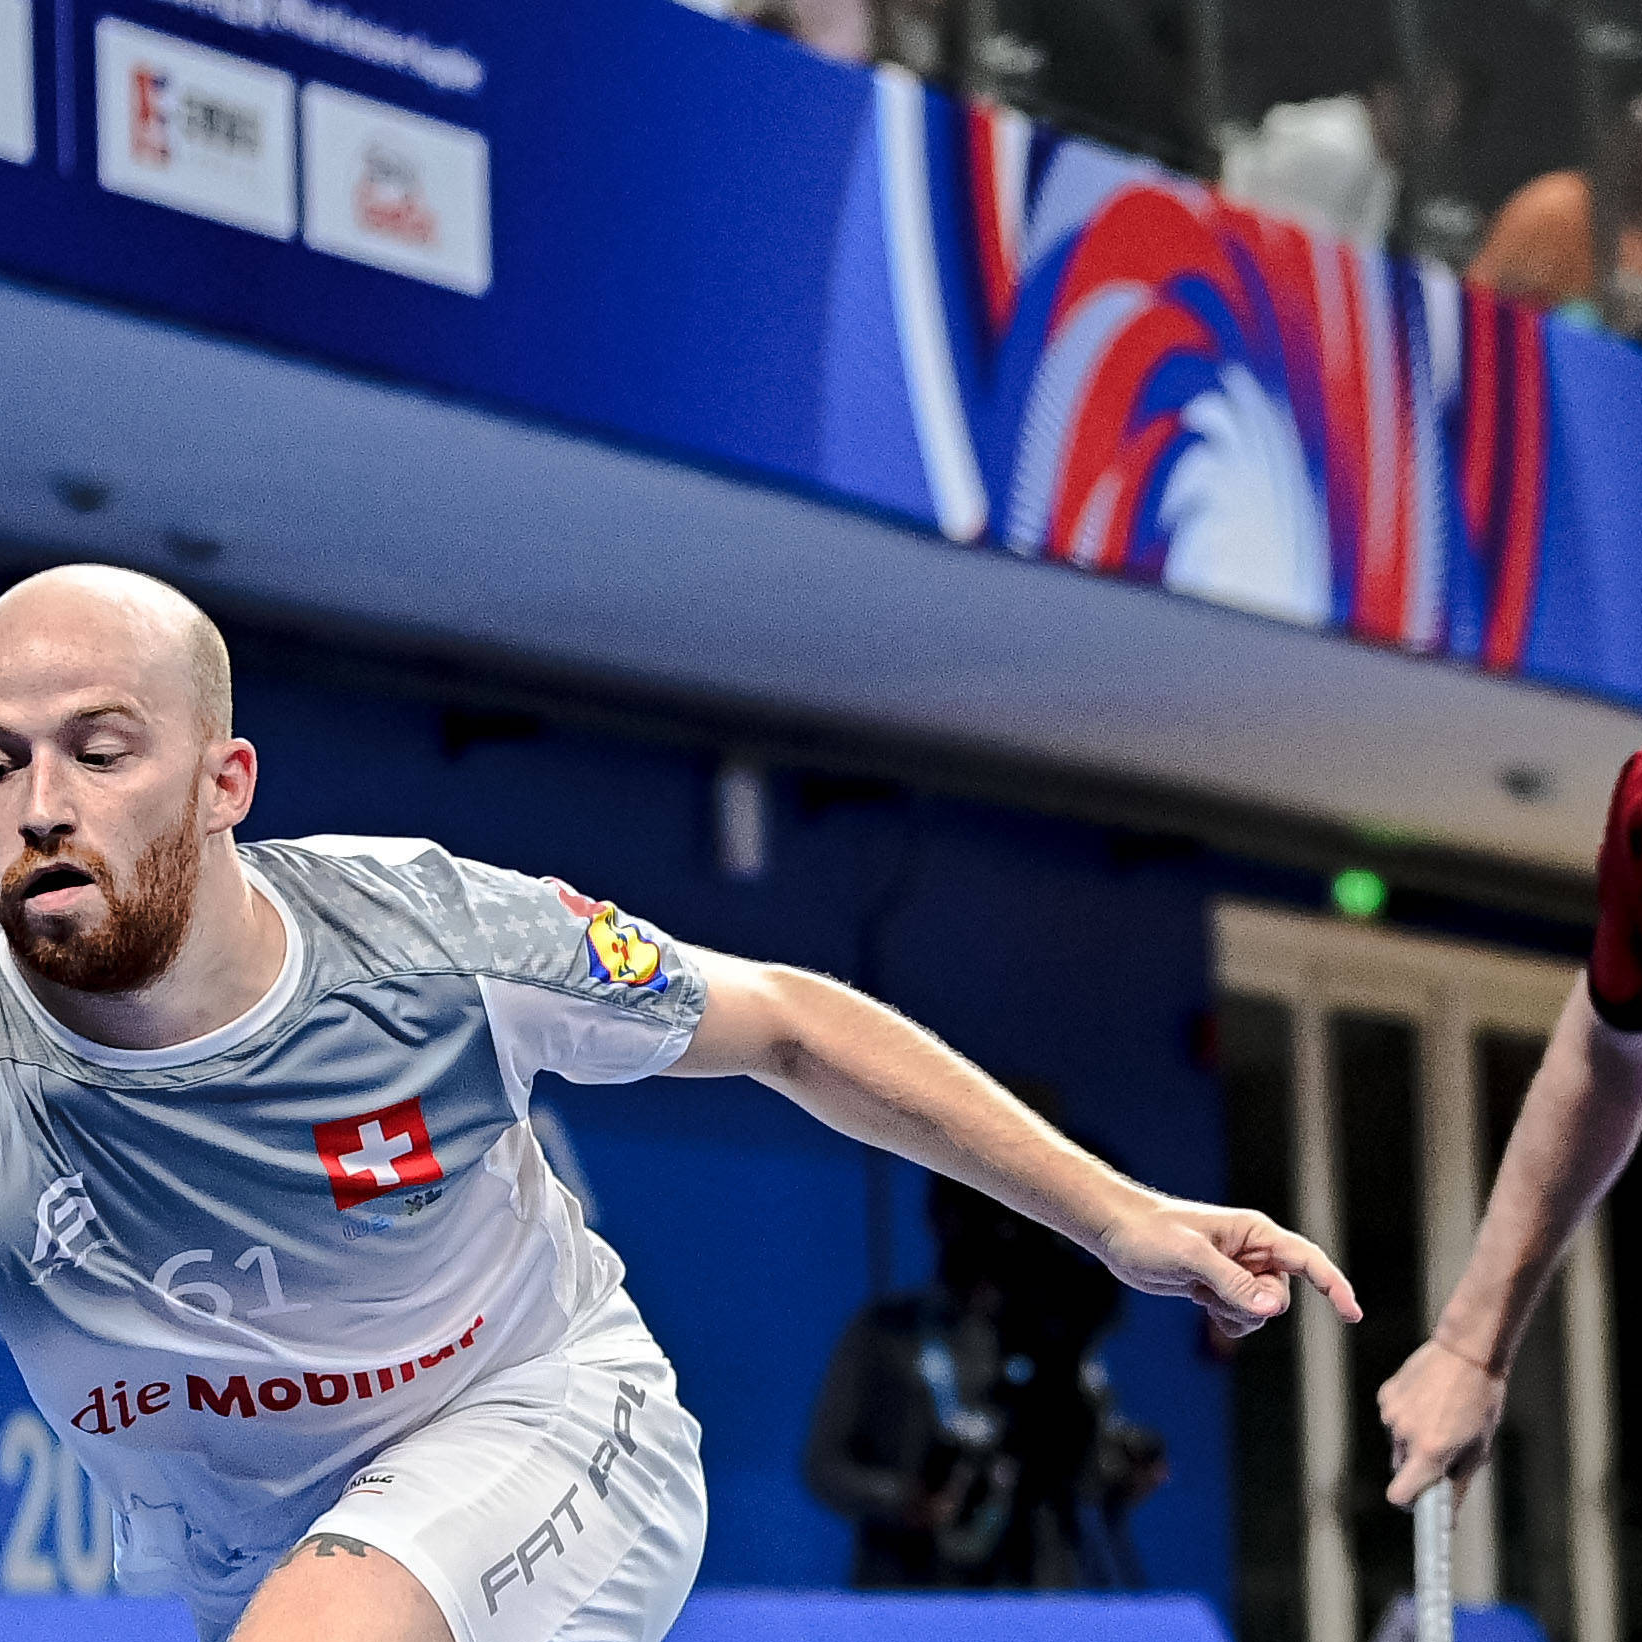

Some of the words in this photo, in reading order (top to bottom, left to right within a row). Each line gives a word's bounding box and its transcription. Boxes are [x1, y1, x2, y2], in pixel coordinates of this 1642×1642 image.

[152, 1245, 312, 1325] 61
[70, 1379, 171, 1436] die
[479, 1482, 585, 1618] FAT
